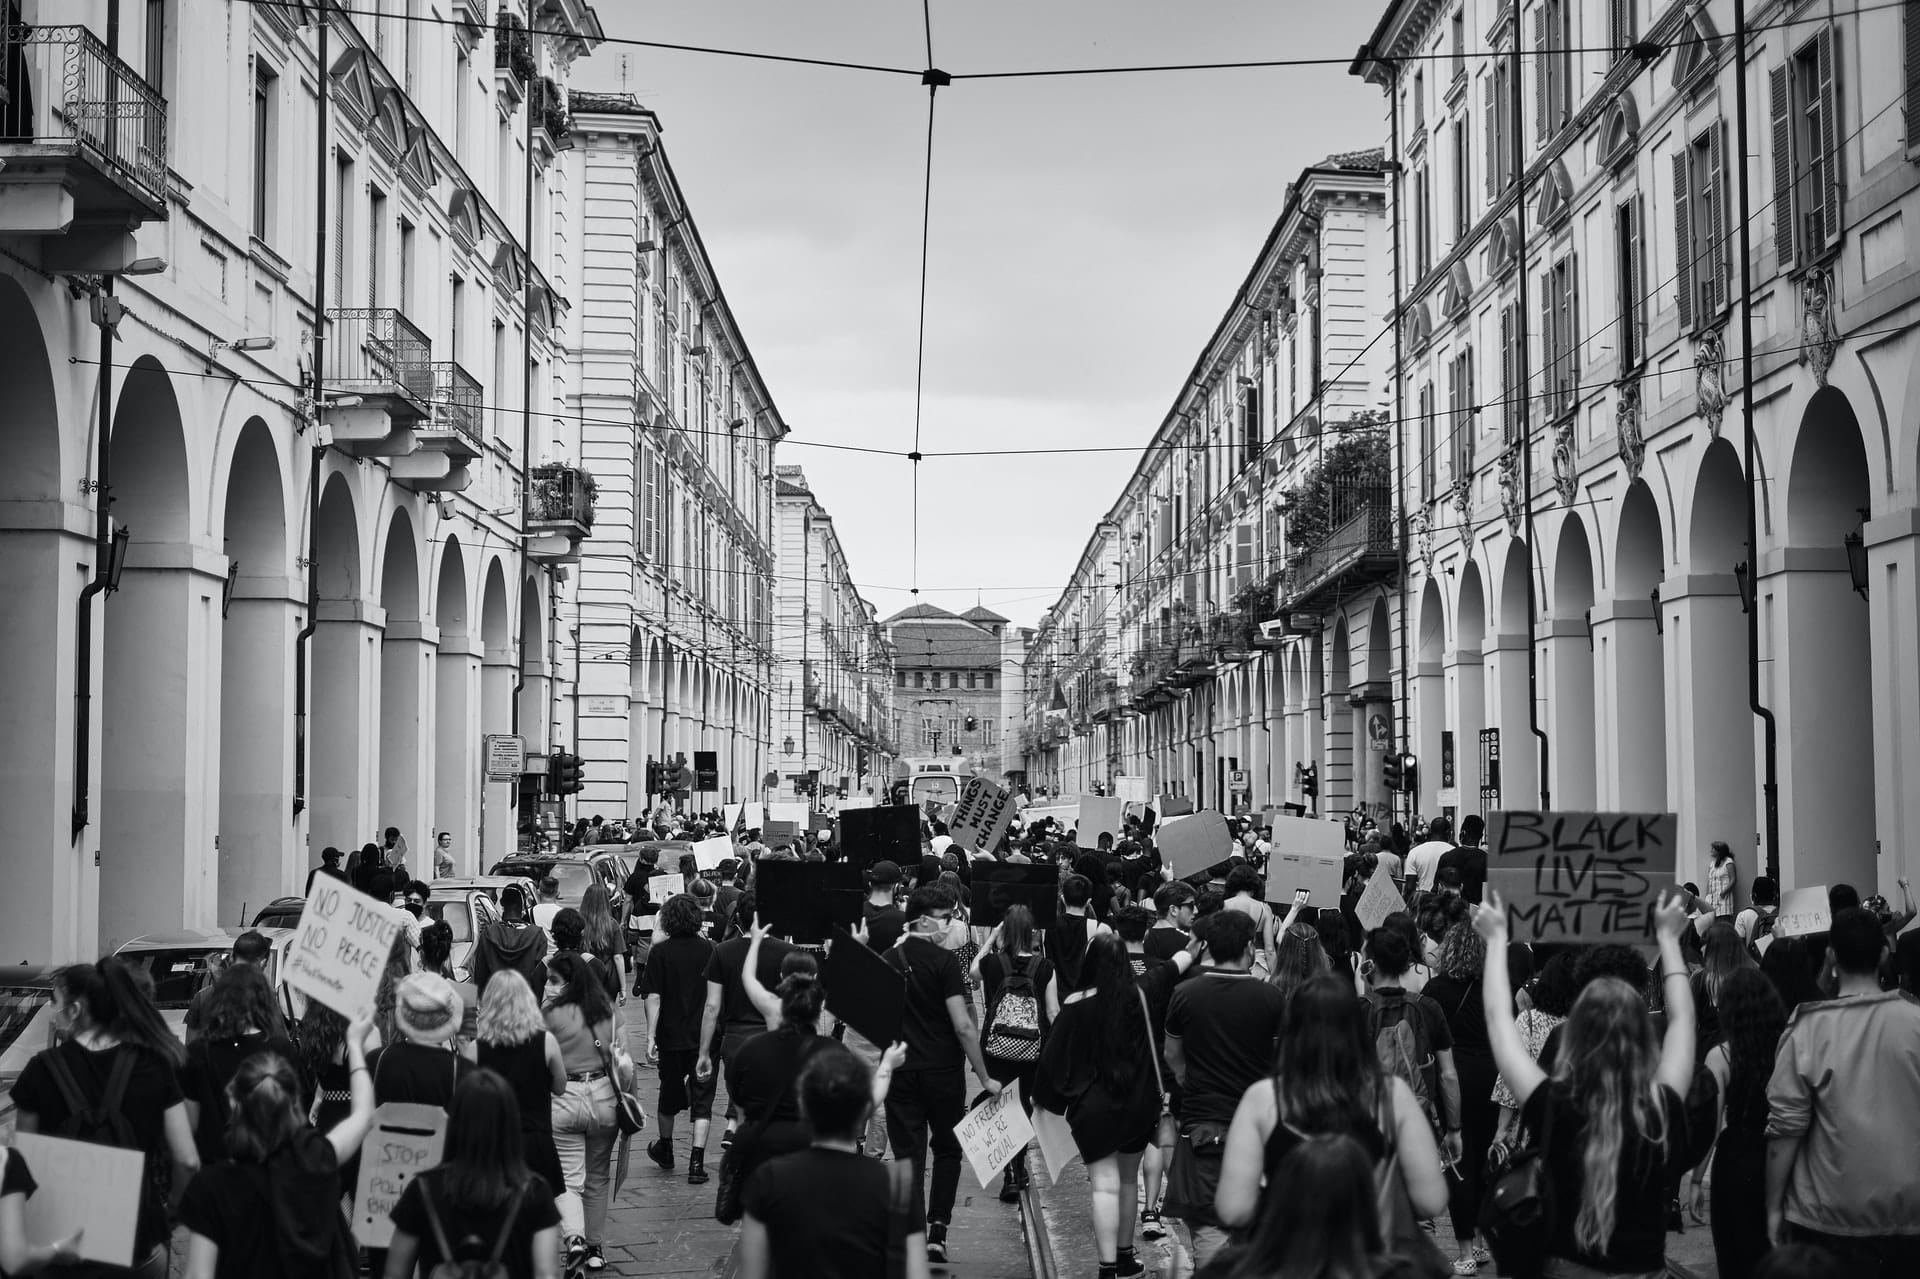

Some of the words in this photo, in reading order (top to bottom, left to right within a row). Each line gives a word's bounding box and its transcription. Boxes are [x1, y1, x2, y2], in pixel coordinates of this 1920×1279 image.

[969, 790, 992, 829] MUST
[975, 790, 1009, 848] CHANGE
[1498, 811, 1663, 856] BLACK
[1535, 853, 1650, 899] LIVES
[313, 888, 340, 916] NO
[347, 901, 398, 948] JUSTICE
[300, 923, 327, 950] NO
[336, 936, 379, 978] PEACE
[962, 1122, 976, 1143] NO
[987, 1134, 1018, 1170] EQUAL
[381, 1143, 429, 1166] STOP
[369, 1176, 404, 1198] POLI
